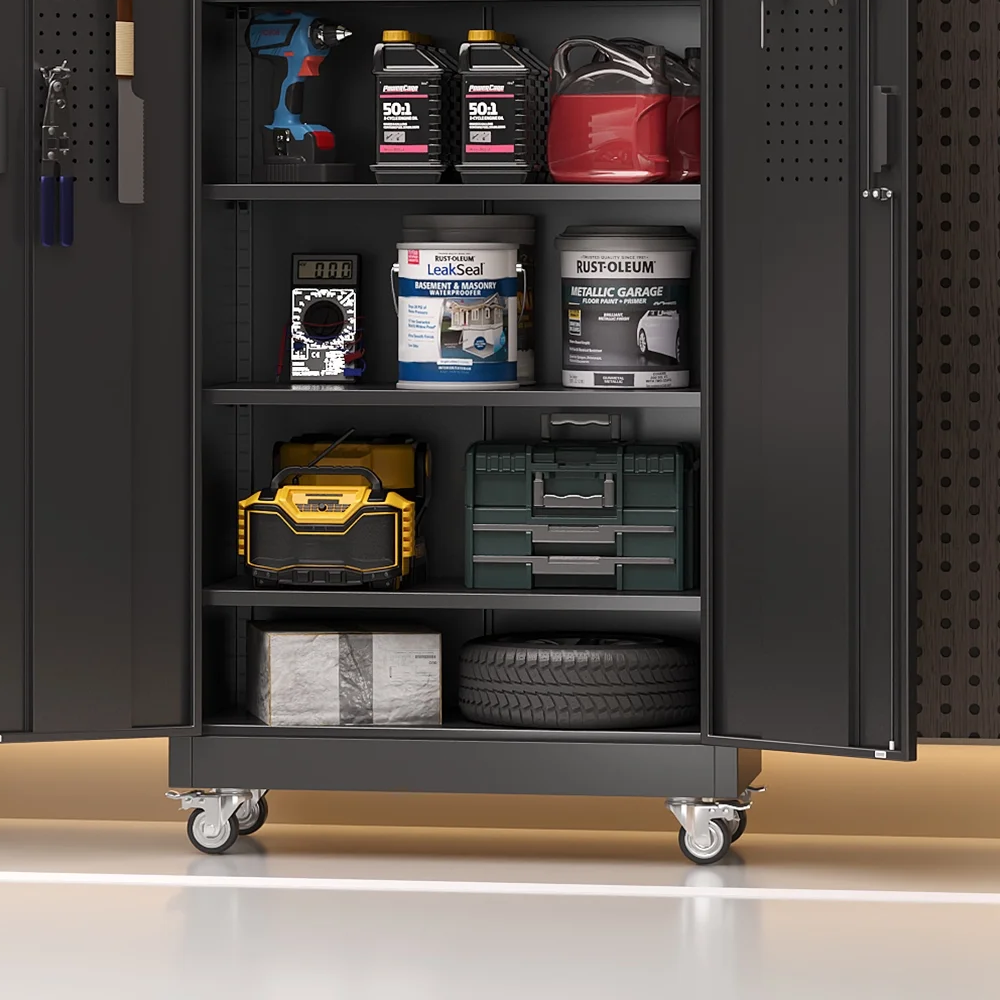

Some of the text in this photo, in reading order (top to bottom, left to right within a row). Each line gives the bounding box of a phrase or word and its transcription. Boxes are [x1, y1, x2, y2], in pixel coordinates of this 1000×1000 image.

[383, 102, 412, 116] 50:1
[469, 102, 498, 116] 50:1
[428, 263, 484, 276] LeakSeal
[415, 281, 497, 290] BASEMENT & MASONRY
[571, 286, 664, 297] METALLIC GARAGE
